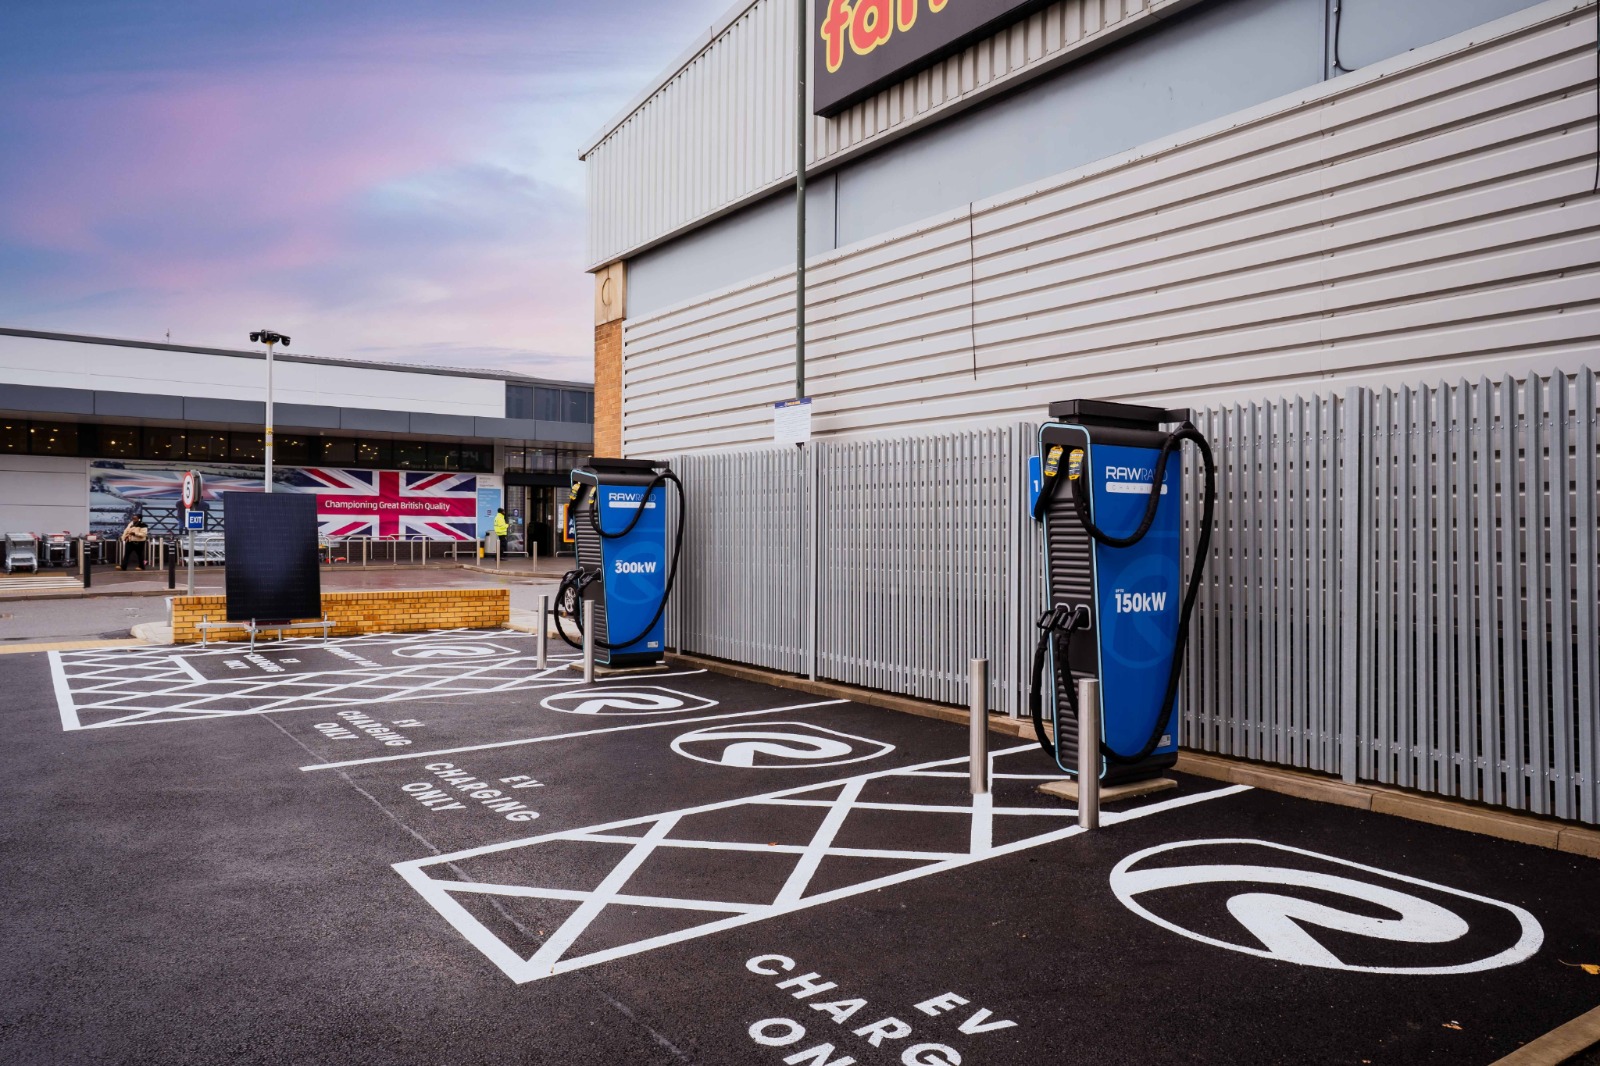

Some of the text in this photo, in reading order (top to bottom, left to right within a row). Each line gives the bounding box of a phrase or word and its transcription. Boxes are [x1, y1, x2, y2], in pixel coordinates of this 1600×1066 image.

[186, 481, 190, 498] 5
[1033, 480, 1039, 492] 1
[325, 500, 450, 512] Championing Great British Quality
[614, 561, 657, 574] 300kW
[1115, 592, 1167, 613] 150kW
[313, 722, 360, 740] ONLY
[337, 710, 412, 746] CHARGING
[499, 775, 545, 789] EV
[401, 782, 467, 811] ONLY
[425, 763, 540, 822] CHARGING
[913, 992, 1018, 1035] EV
